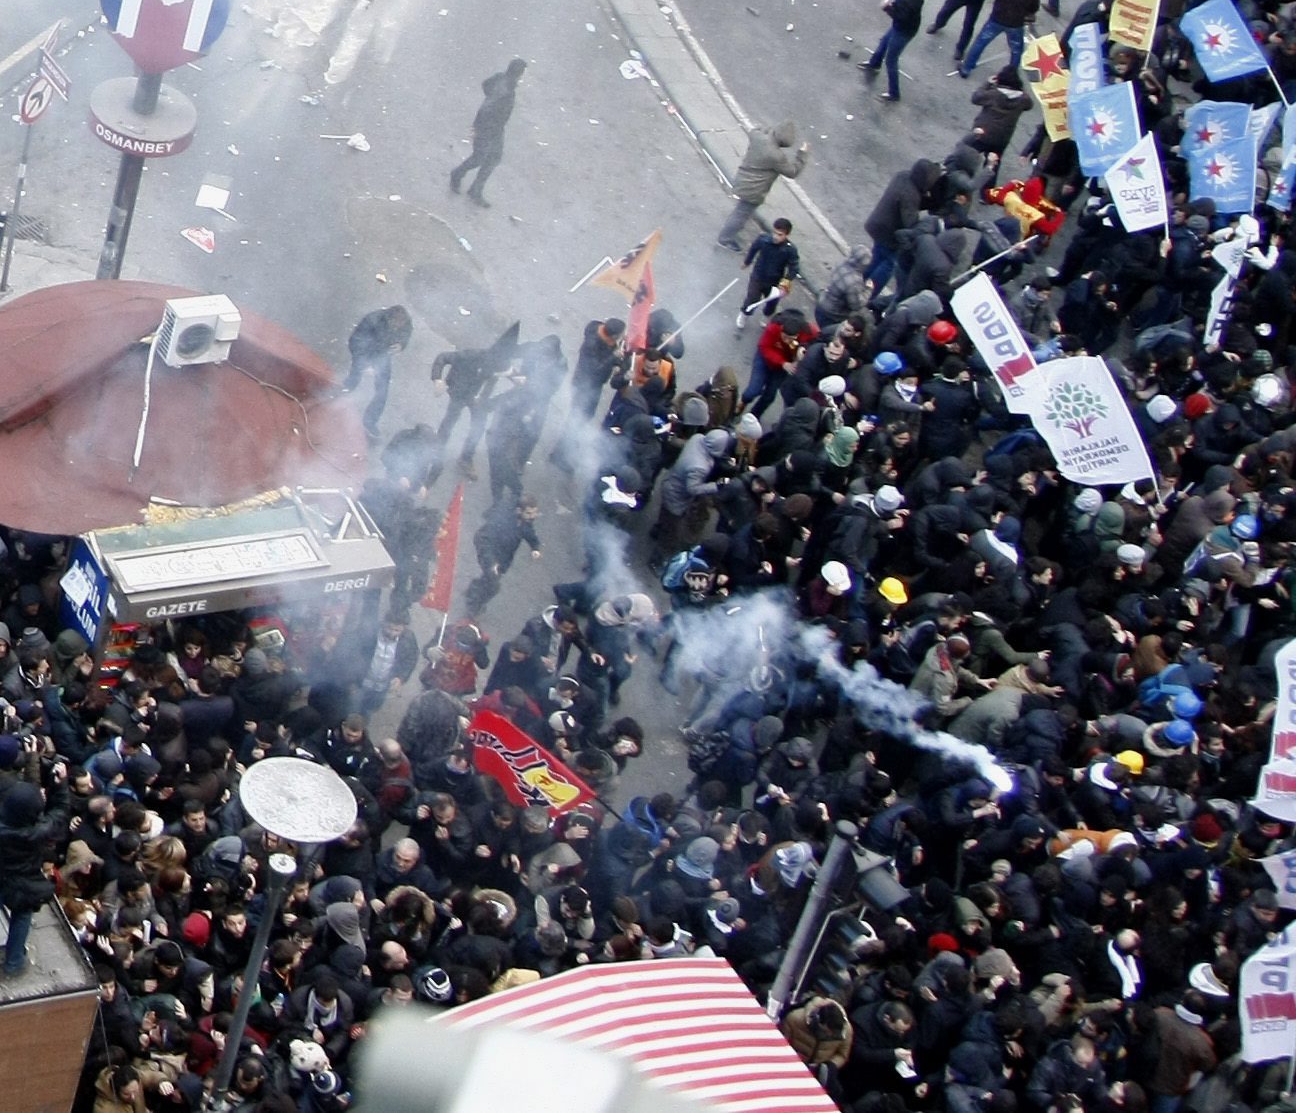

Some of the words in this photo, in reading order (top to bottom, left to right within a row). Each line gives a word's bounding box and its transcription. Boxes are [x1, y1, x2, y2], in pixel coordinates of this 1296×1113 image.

[95, 122, 175, 154] OSMANBEY
[323, 573, 372, 594] DERGİ
[146, 599, 209, 620] GAZETE
